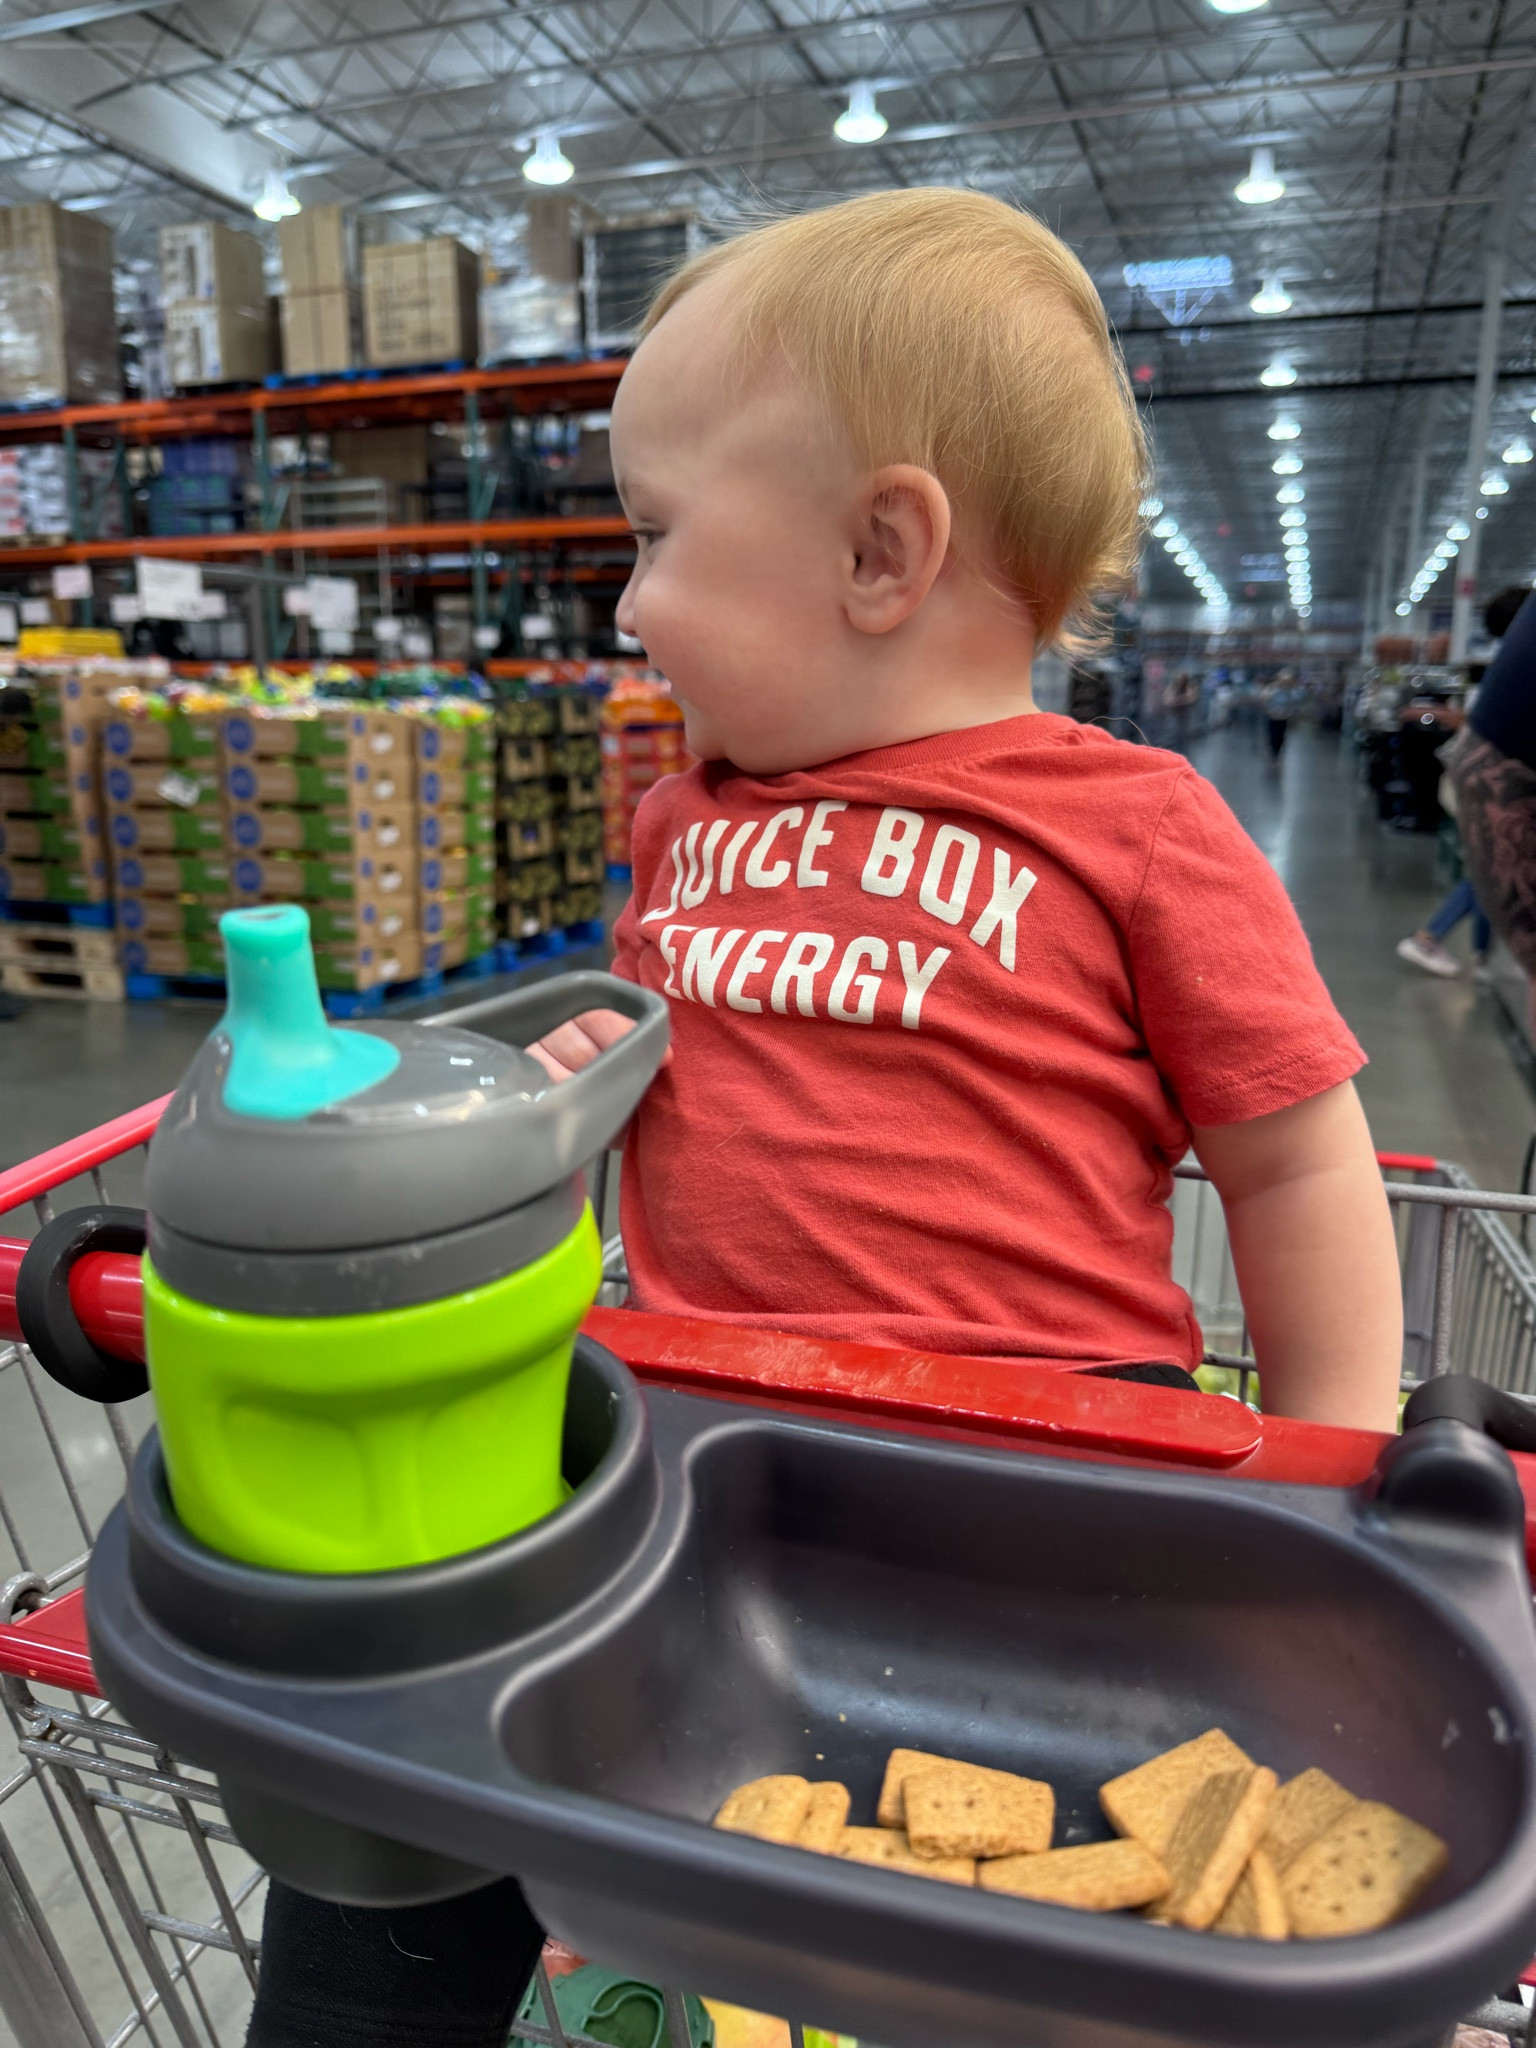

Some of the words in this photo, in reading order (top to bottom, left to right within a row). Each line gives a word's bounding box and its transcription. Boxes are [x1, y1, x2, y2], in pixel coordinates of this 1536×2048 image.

[641, 800, 849, 924] JUICE
[861, 806, 1038, 973] BOX
[660, 924, 951, 1030] ENERGY
